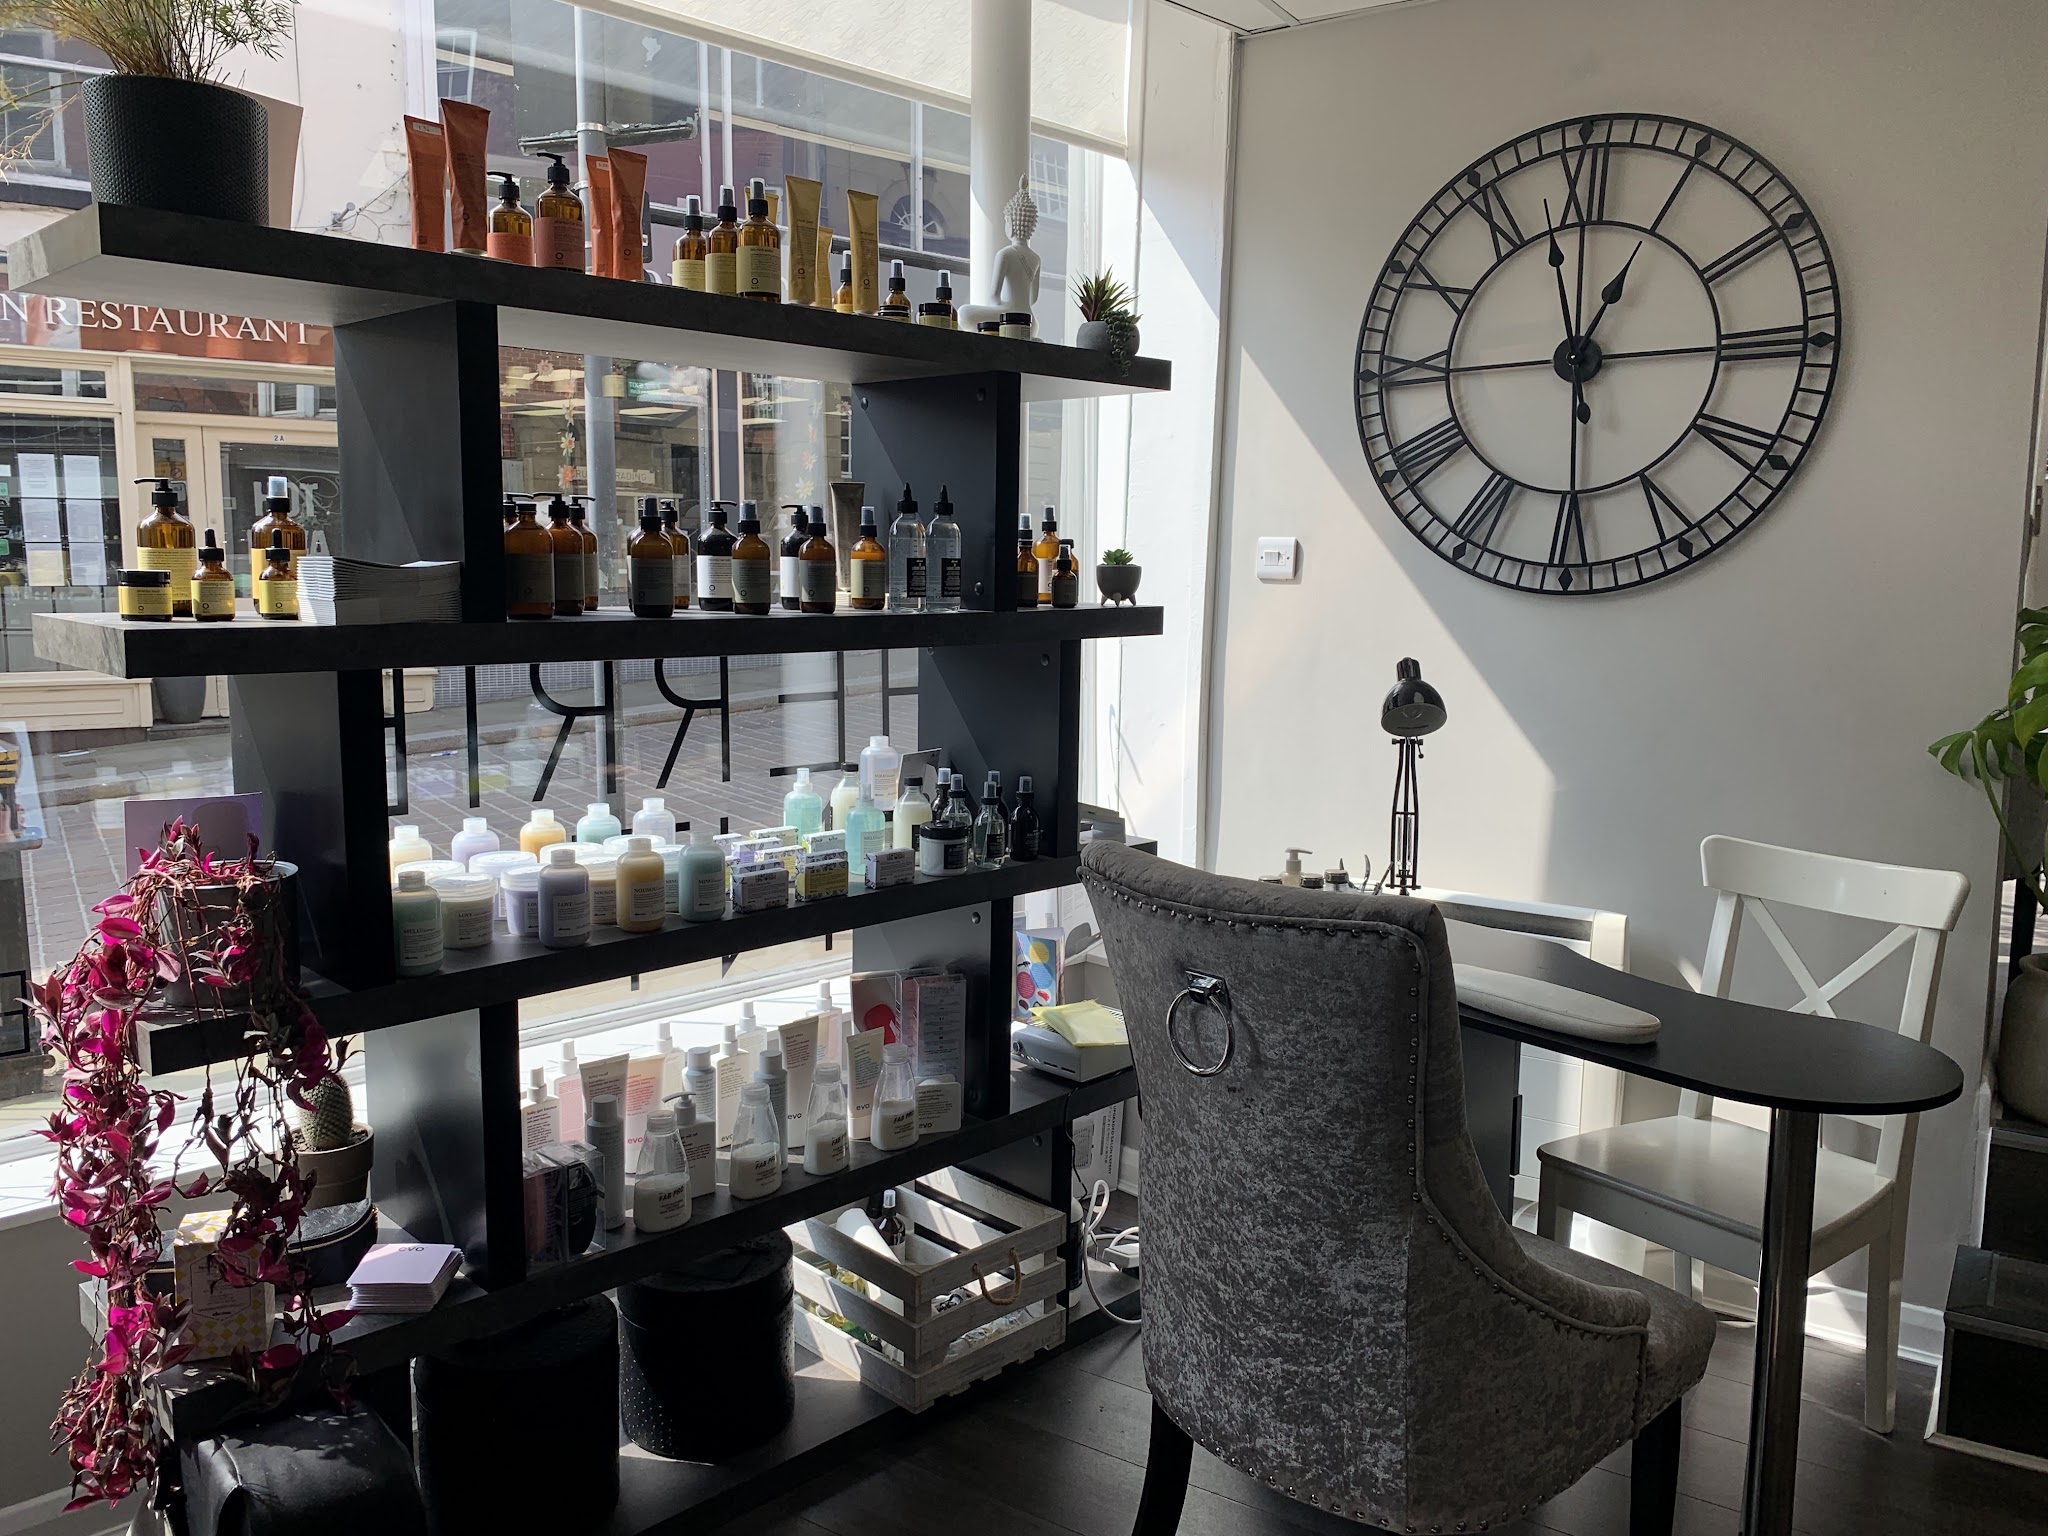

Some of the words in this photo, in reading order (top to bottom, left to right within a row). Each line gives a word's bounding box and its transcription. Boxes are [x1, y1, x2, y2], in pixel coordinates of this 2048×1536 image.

[44, 294, 314, 345] RESTAURANT
[615, 471, 647, 482] RADING
[856, 1103, 870, 1111] evo
[627, 1136, 644, 1145] evo
[658, 1192, 672, 1202] FAB
